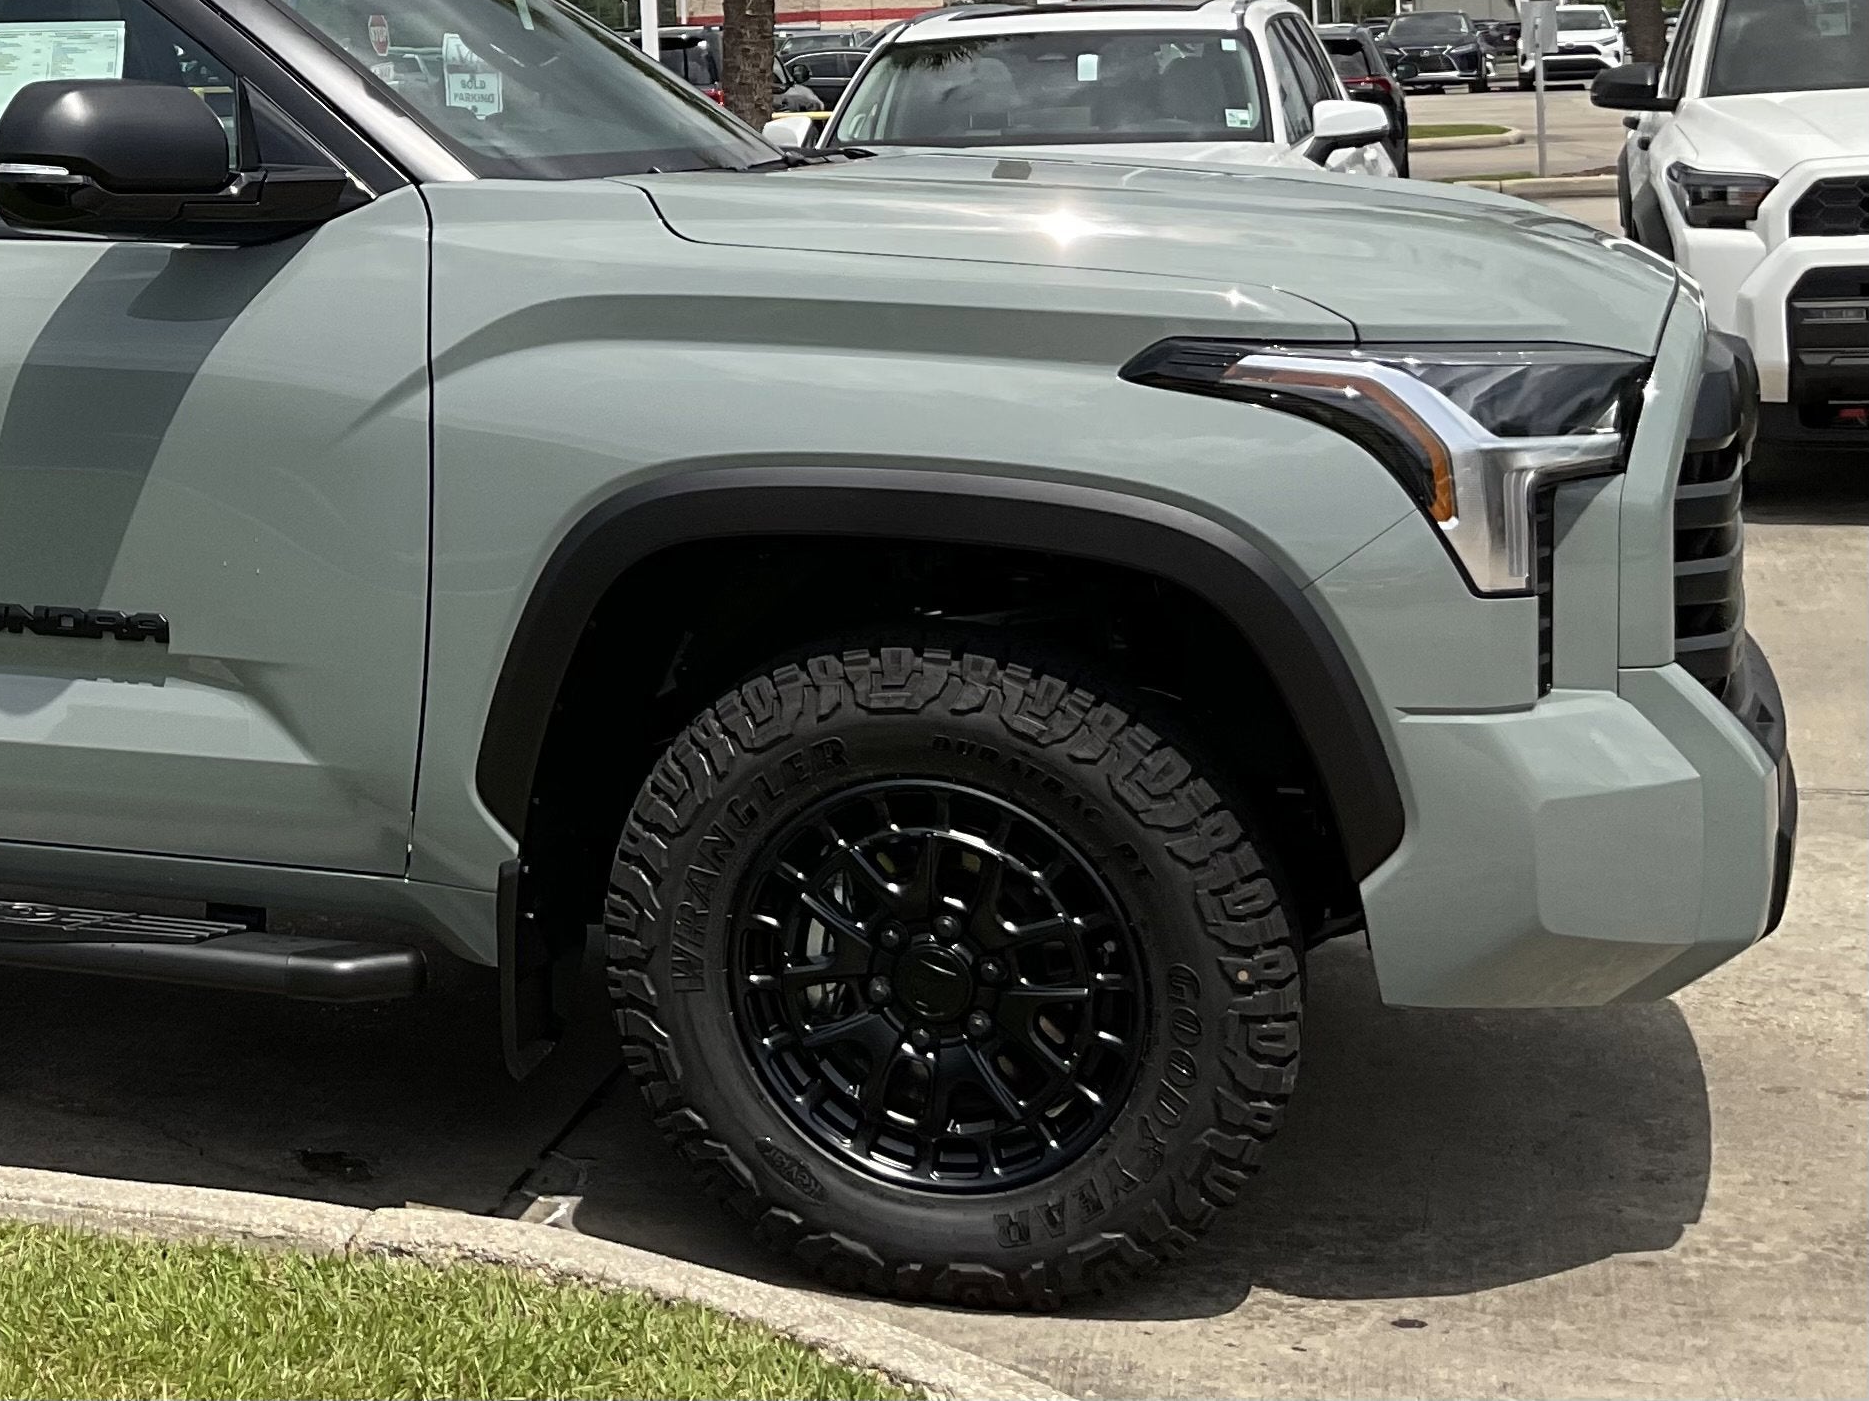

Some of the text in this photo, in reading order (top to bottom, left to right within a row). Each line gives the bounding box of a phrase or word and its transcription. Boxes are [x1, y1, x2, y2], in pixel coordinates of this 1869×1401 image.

[453, 92, 495, 103] PARKING
[460, 79, 486, 90] SOLD
[932, 735, 1104, 824] DURATRAC
[670, 736, 850, 992] WRANGLER
[994, 962, 1201, 1248] GOODYEAR
